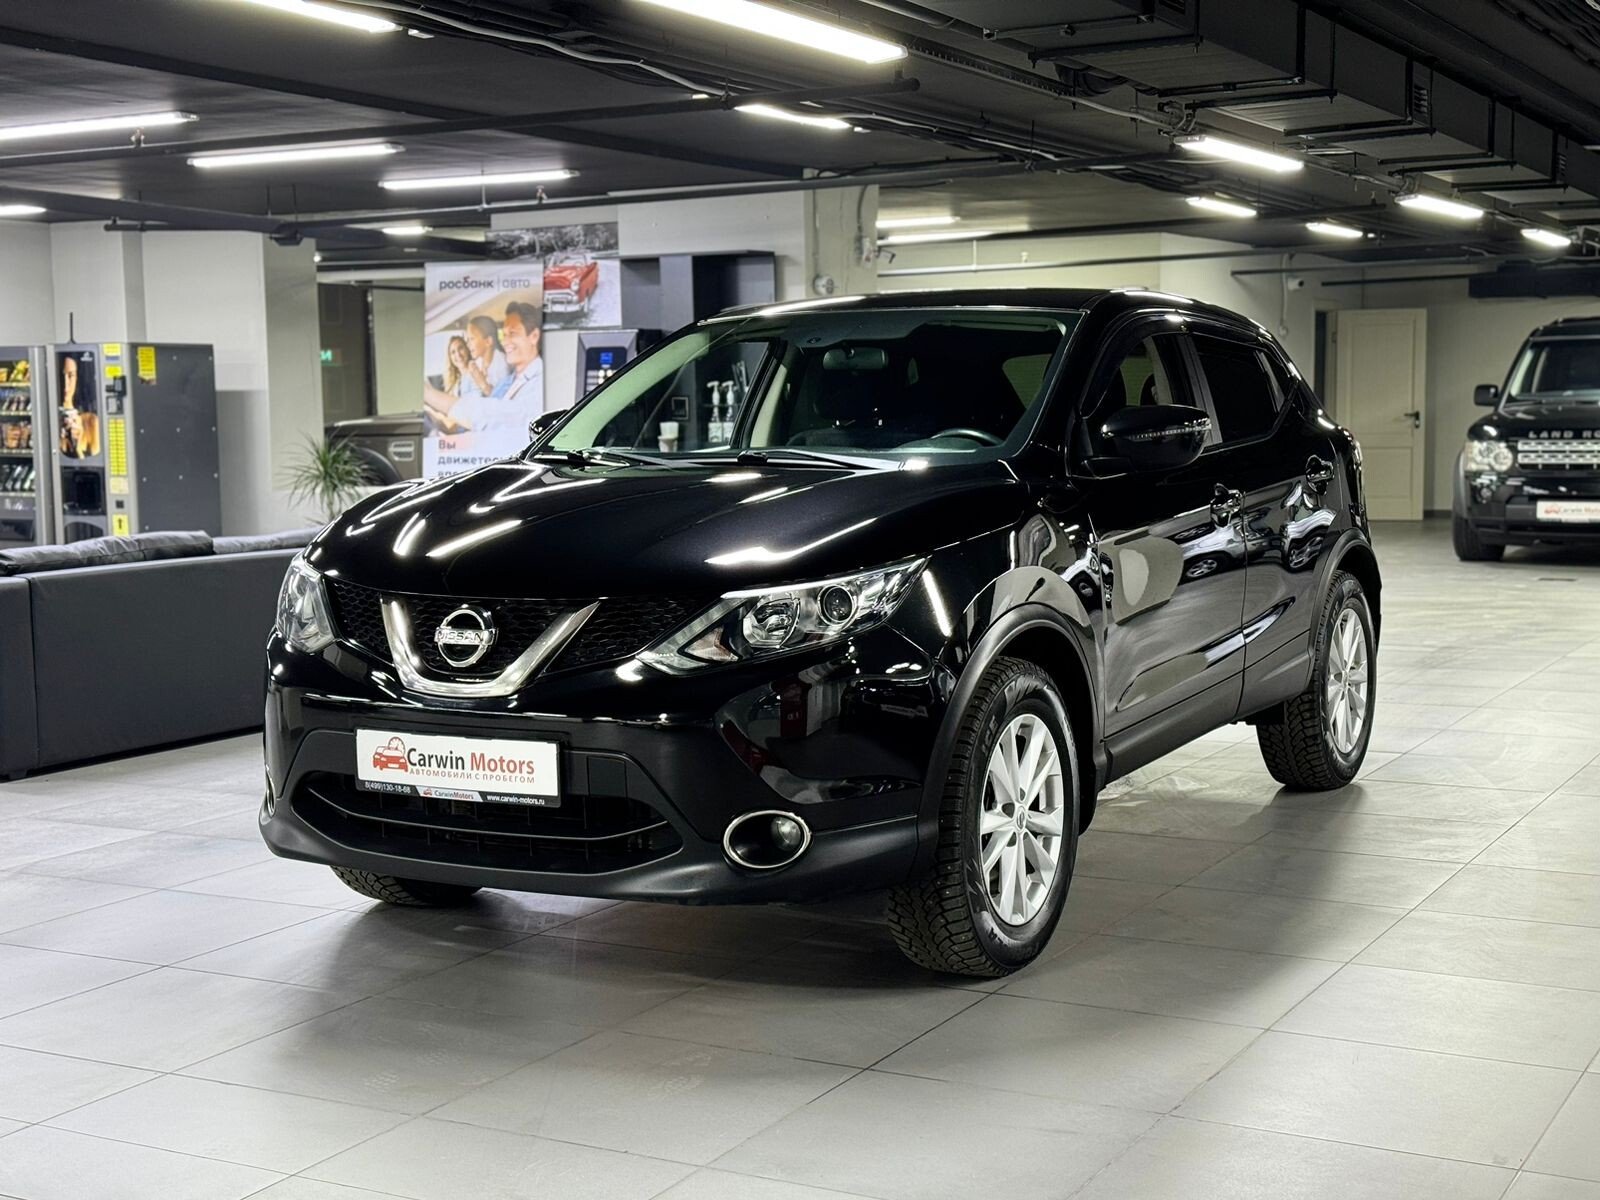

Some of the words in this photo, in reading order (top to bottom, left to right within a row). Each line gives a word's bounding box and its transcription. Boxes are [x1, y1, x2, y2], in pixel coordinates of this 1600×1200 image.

[439, 275, 494, 291] росбанк
[502, 279, 530, 288] авто
[1528, 430, 1574, 439] LAND
[438, 439, 456, 450] Вы
[436, 629, 484, 643] NISSAN
[407, 748, 465, 770] Carwin
[470, 752, 535, 775] Motors
[409, 768, 472, 780] АВТОМОБИЛИ
[483, 774, 535, 783] ПРОБЕГОМ
